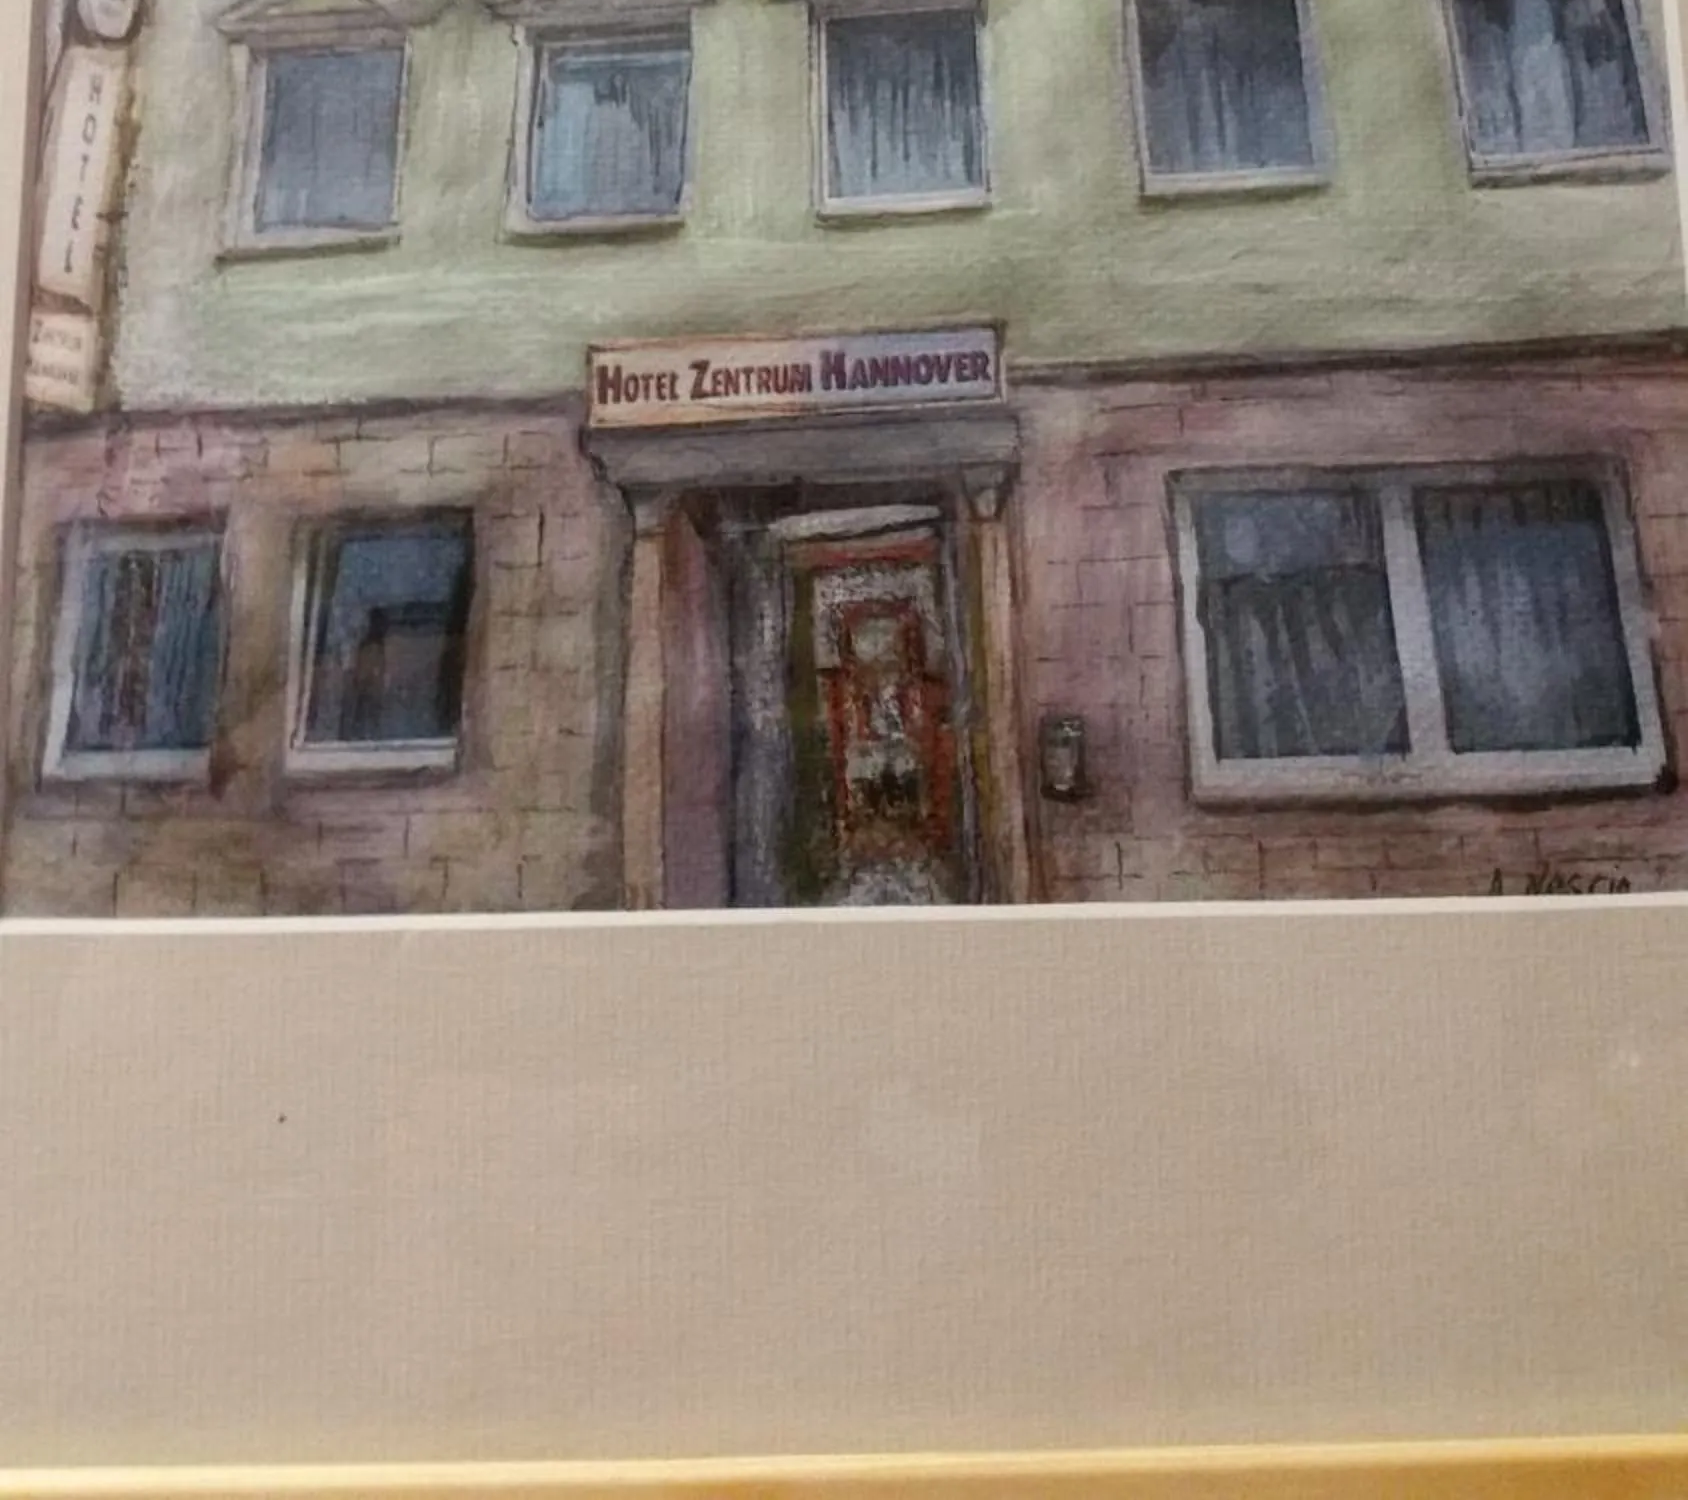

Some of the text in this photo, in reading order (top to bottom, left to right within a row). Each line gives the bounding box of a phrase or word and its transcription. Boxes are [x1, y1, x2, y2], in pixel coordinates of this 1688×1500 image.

[64, 74, 103, 274] HOTEL
[597, 350, 991, 405] HOTEL ZENTRUM HANNOVER
